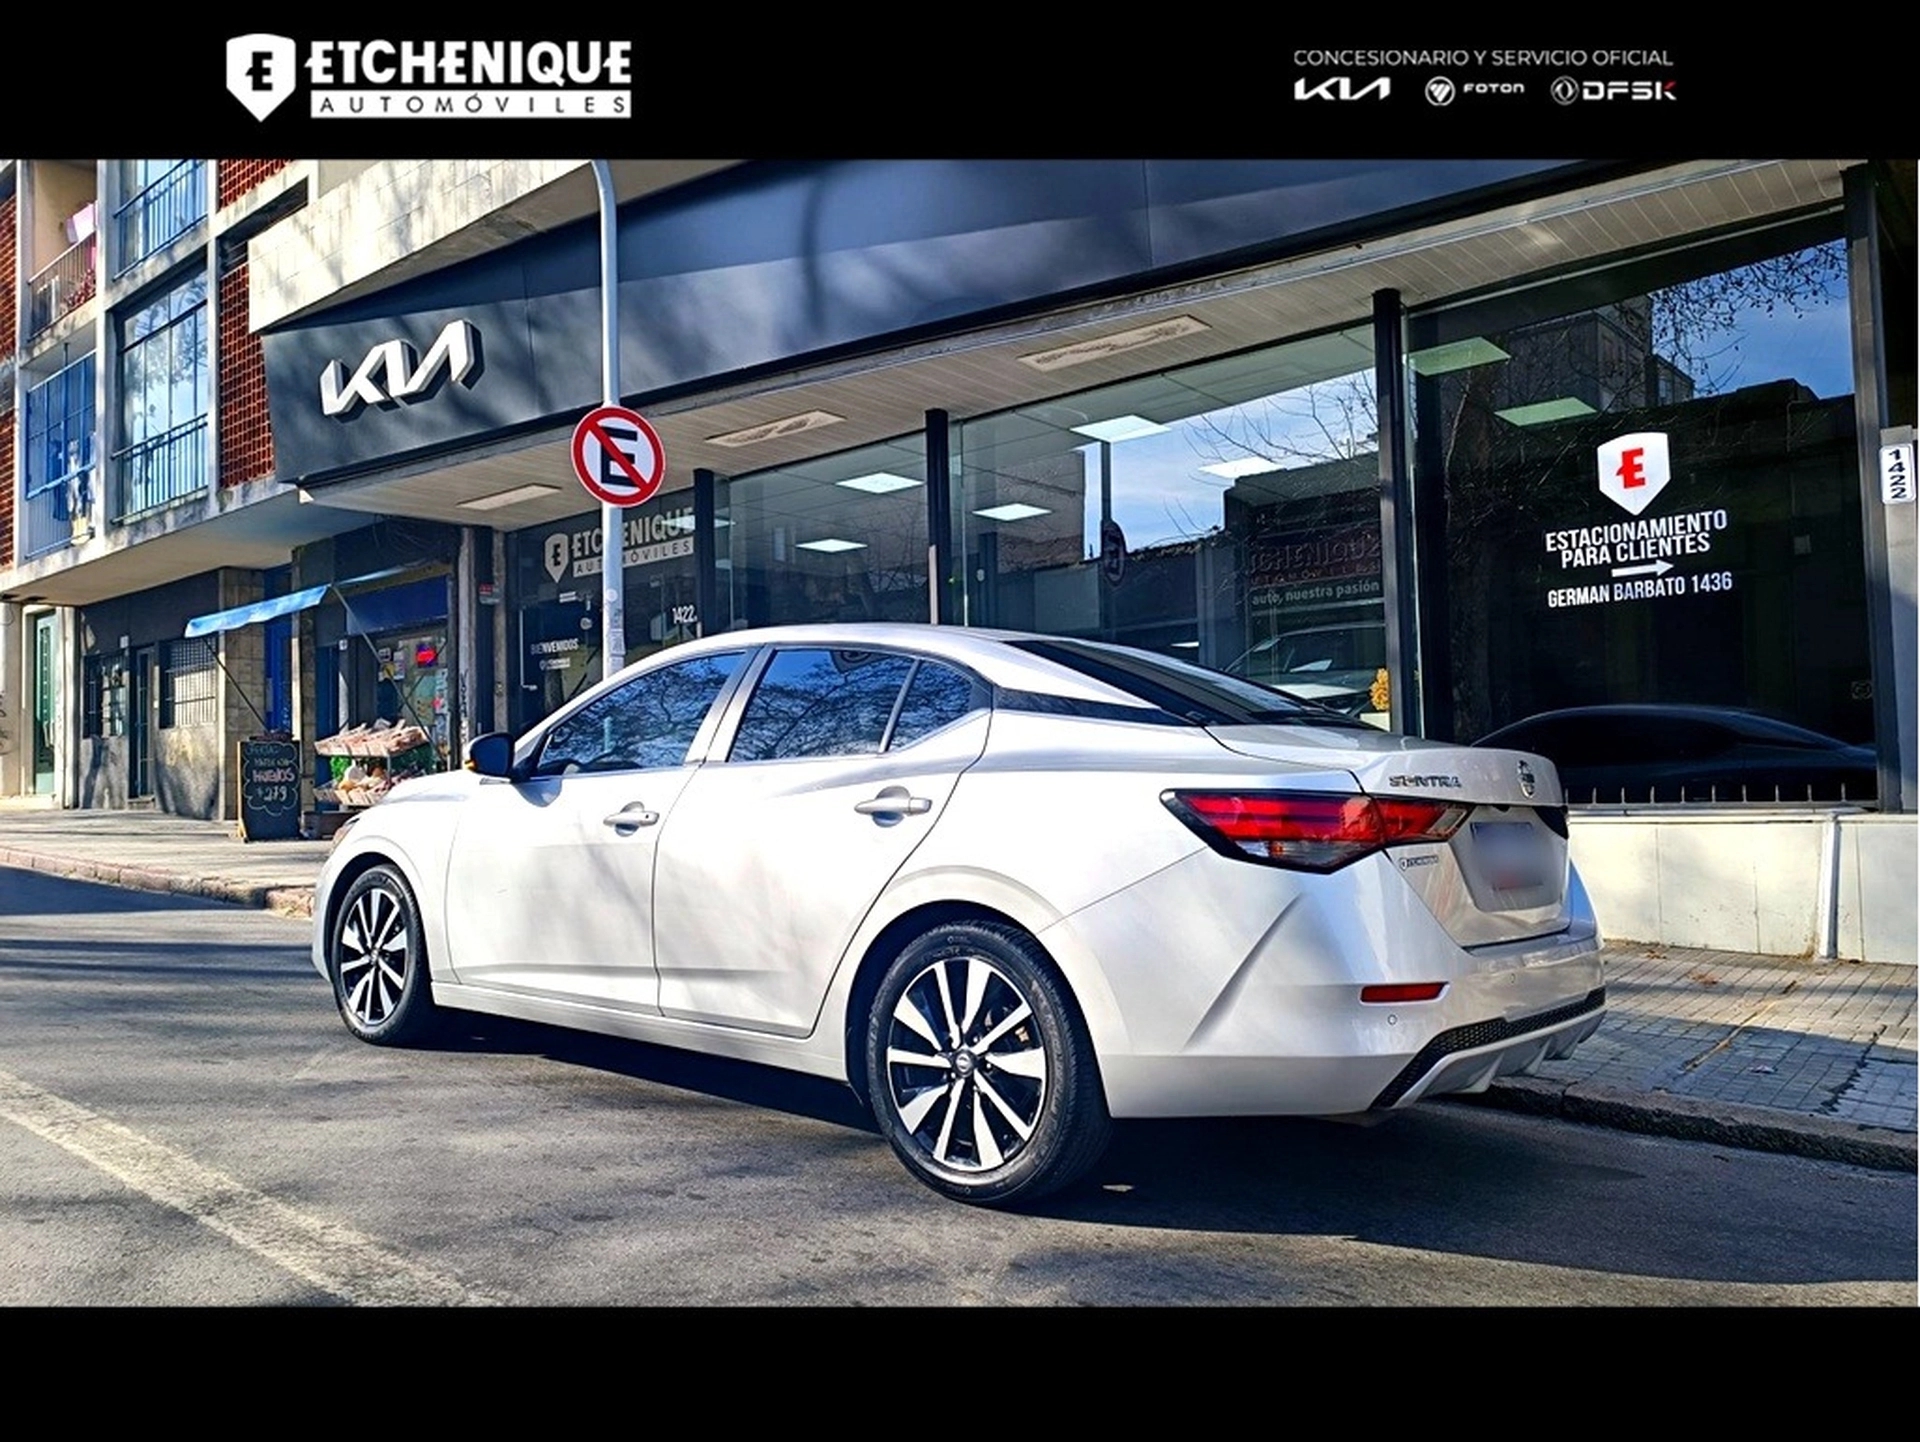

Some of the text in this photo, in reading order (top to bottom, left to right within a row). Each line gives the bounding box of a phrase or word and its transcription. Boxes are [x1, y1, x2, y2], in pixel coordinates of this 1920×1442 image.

[319, 319, 475, 417] KIA
[1888, 449, 1908, 499] 1422
[571, 507, 694, 557] ETCENIQUE
[1545, 509, 1728, 552] ESTACIONAMIENTO
[1561, 532, 1711, 569] PARA CLIENTES
[1285, 587, 1333, 602] nuestra
[1337, 580, 1380, 598] pasión
[1547, 571, 1733, 608] GERMAN BARBATO 1436
[1388, 775, 1462, 788] SENTRA
